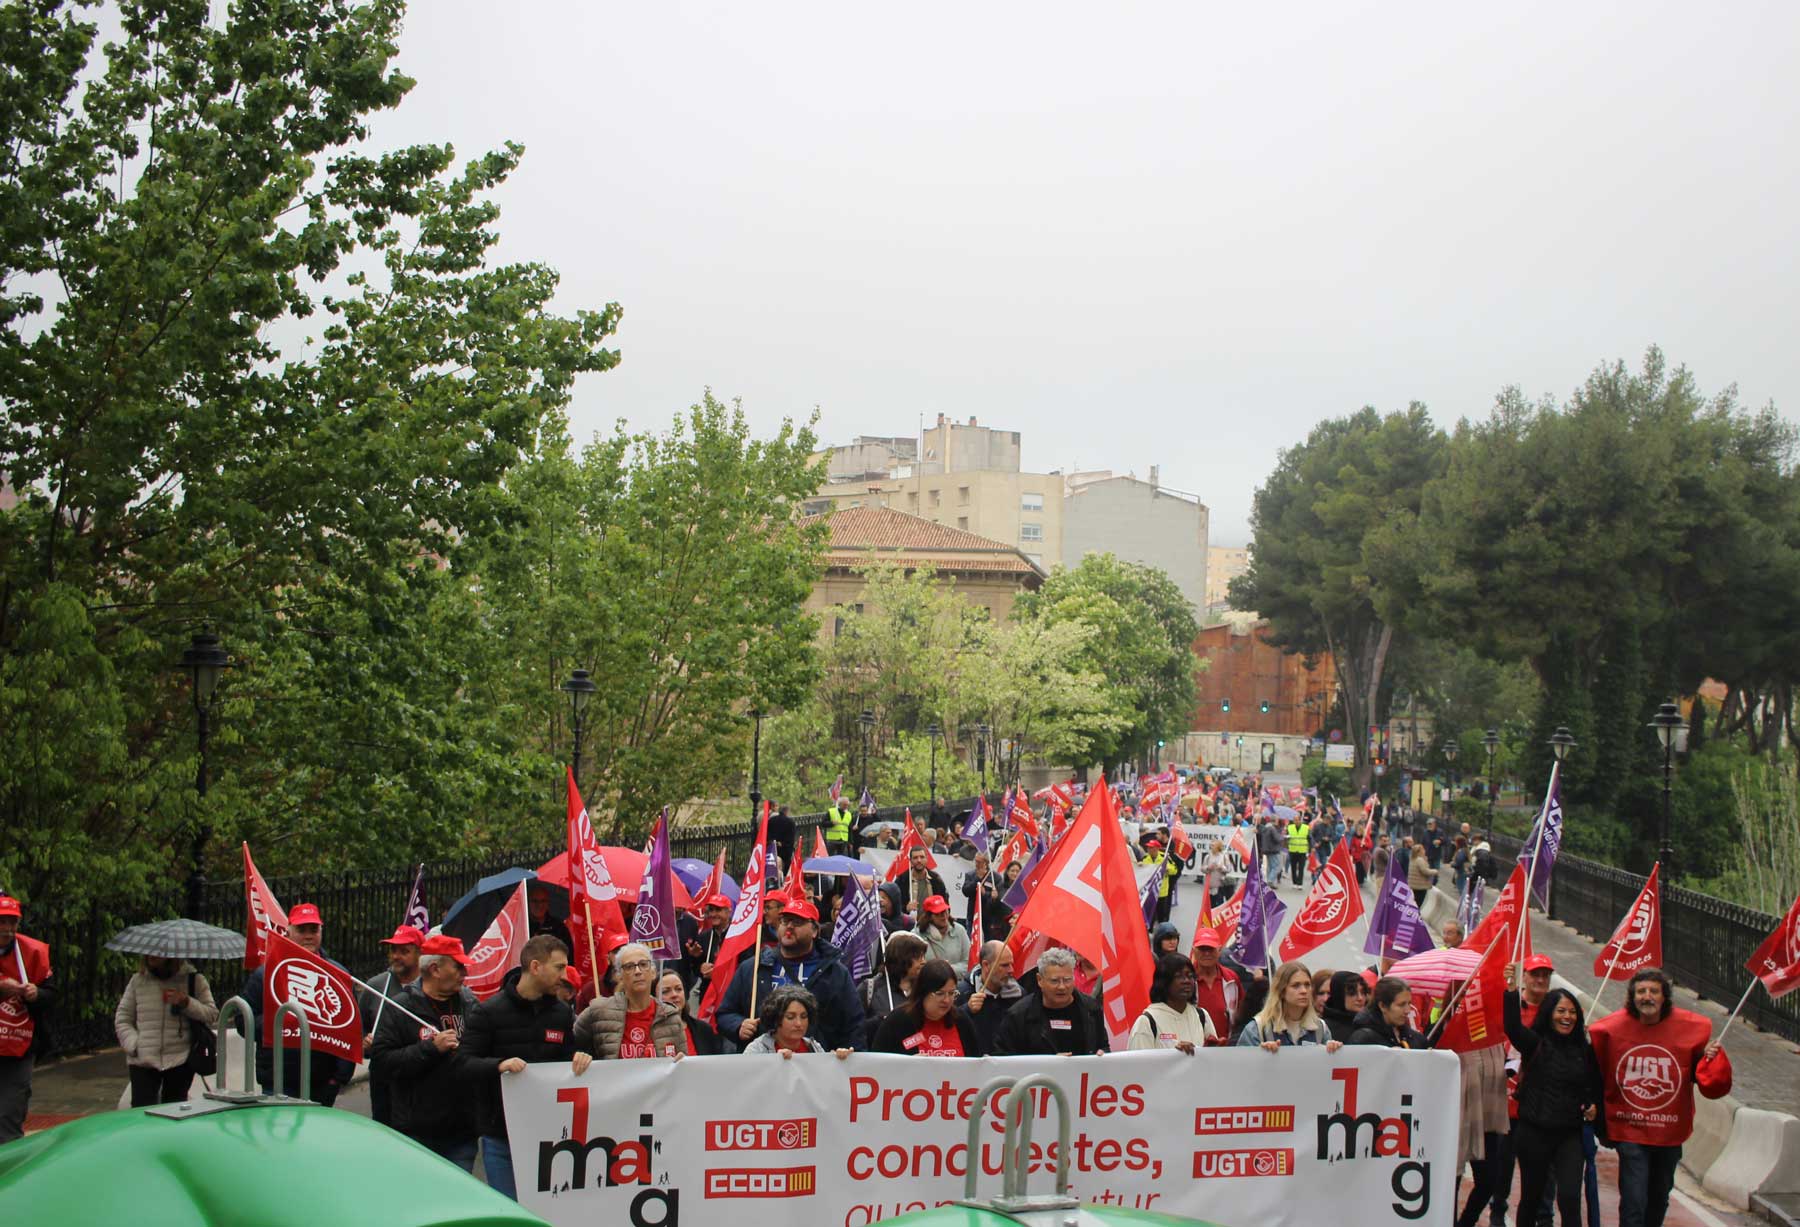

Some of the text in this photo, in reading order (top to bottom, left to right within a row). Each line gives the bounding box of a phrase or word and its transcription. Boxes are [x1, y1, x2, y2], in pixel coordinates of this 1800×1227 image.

[1626, 1056, 1671, 1081] UGT
[1078, 1072, 1146, 1118] les
[1200, 1111, 1262, 1131] CCOO
[715, 1124, 774, 1148] UGT
[1200, 1152, 1251, 1176] UGT
[710, 1174, 786, 1193] CCOO
